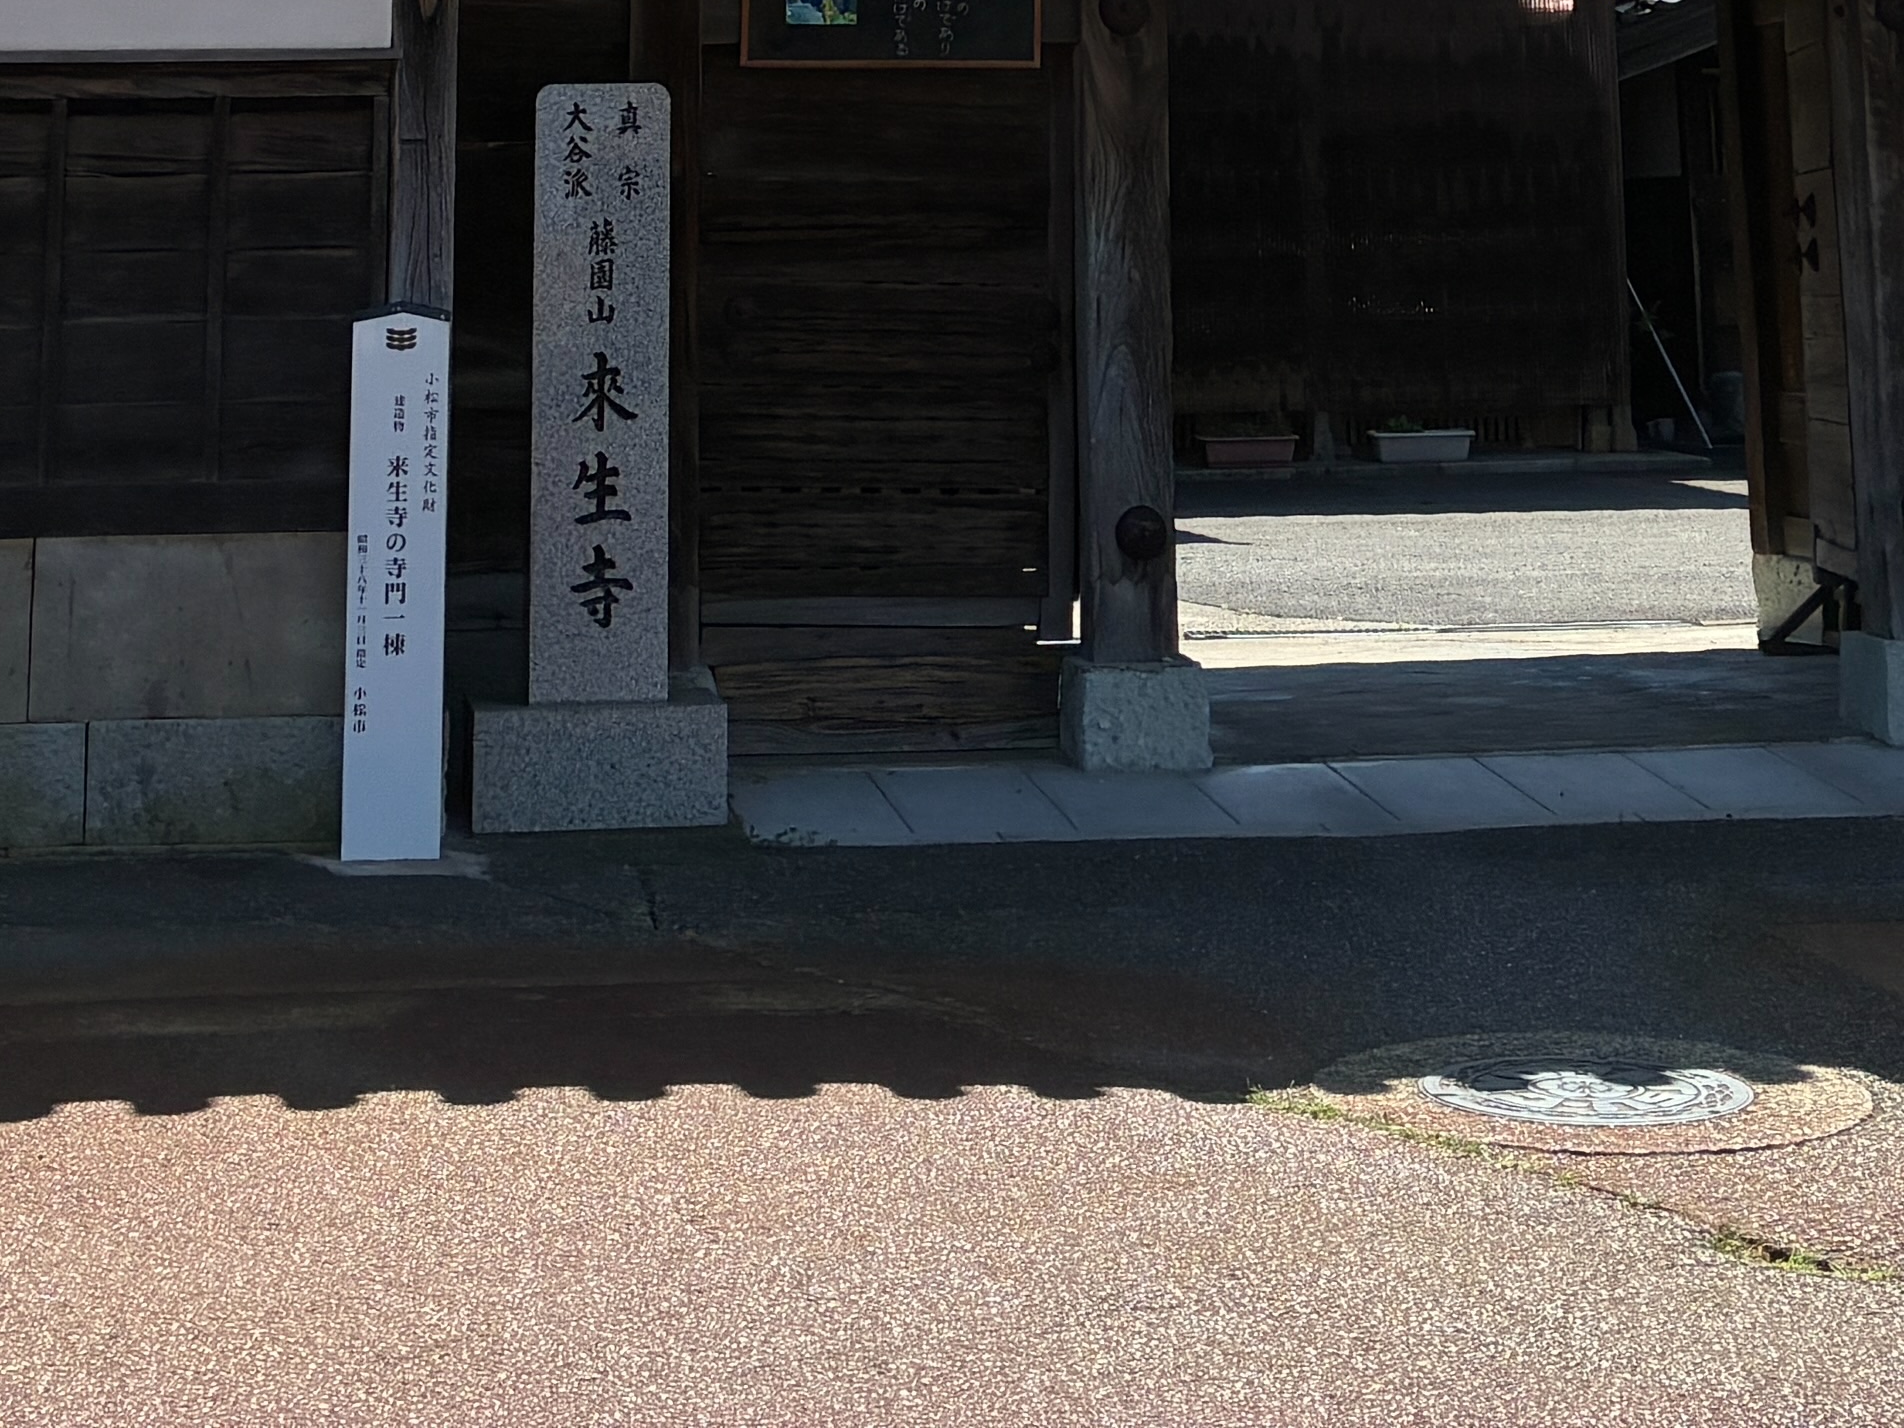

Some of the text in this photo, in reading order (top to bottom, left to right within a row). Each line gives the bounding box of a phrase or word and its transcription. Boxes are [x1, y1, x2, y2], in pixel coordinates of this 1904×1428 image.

[563, 101, 593, 199] 大谷派
[422, 372, 439, 513] 小松市指定文化財
[353, 686, 367, 734] 小松市
